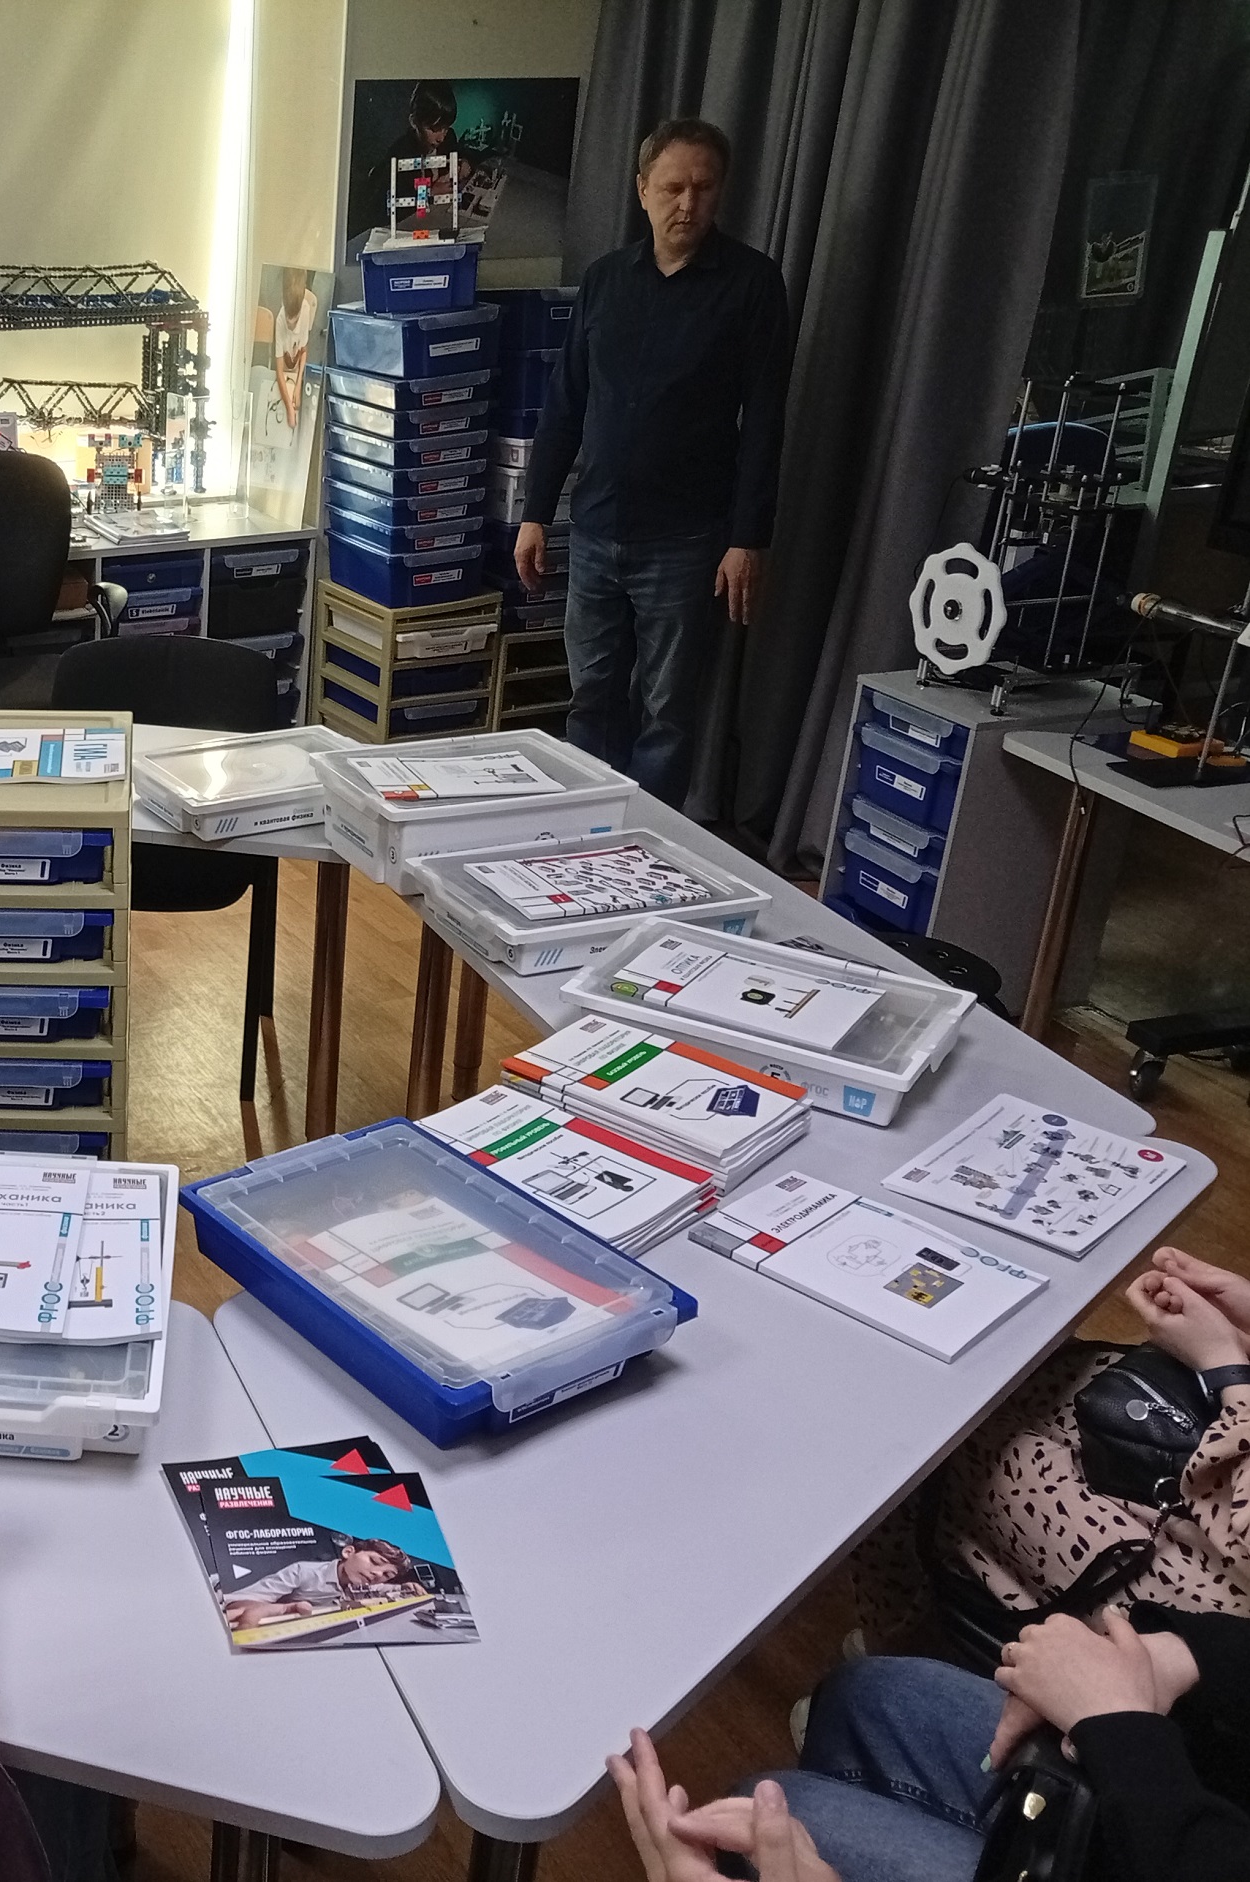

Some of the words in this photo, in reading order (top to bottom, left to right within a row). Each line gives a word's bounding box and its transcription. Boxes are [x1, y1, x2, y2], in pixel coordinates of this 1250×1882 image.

[259, 815, 290, 826] квантовая
[291, 812, 314, 821] физика
[671, 954, 700, 974] ОПТИКА
[606, 1060, 629, 1076] БАЗОВЫЙ
[626, 1050, 647, 1064] УРОВЕНЬ
[800, 1081, 830, 1097] ФГОС
[527, 1122, 551, 1137] УРОВЕНЬ
[42, 1171, 77, 1180] НАУЧНЫЕ
[113, 1177, 147, 1186] НАУЧНЫЕ
[85, 1202, 137, 1210] аника
[770, 1192, 838, 1234] ЭЛЕКТРОДИНАМИКА
[960, 1246, 1028, 1280] ФГОС
[37, 1281, 63, 1323] ФГОС
[135, 1283, 155, 1326] ФГОС
[107, 1424, 120, 1437] 2
[214, 1486, 273, 1501] НАУЧНЫЕ
[219, 1500, 275, 1508] РАЗВЛЕЧЕНИЯ
[225, 1527, 315, 1540] ФГОС-ЛАБОРАТОРИЯ
